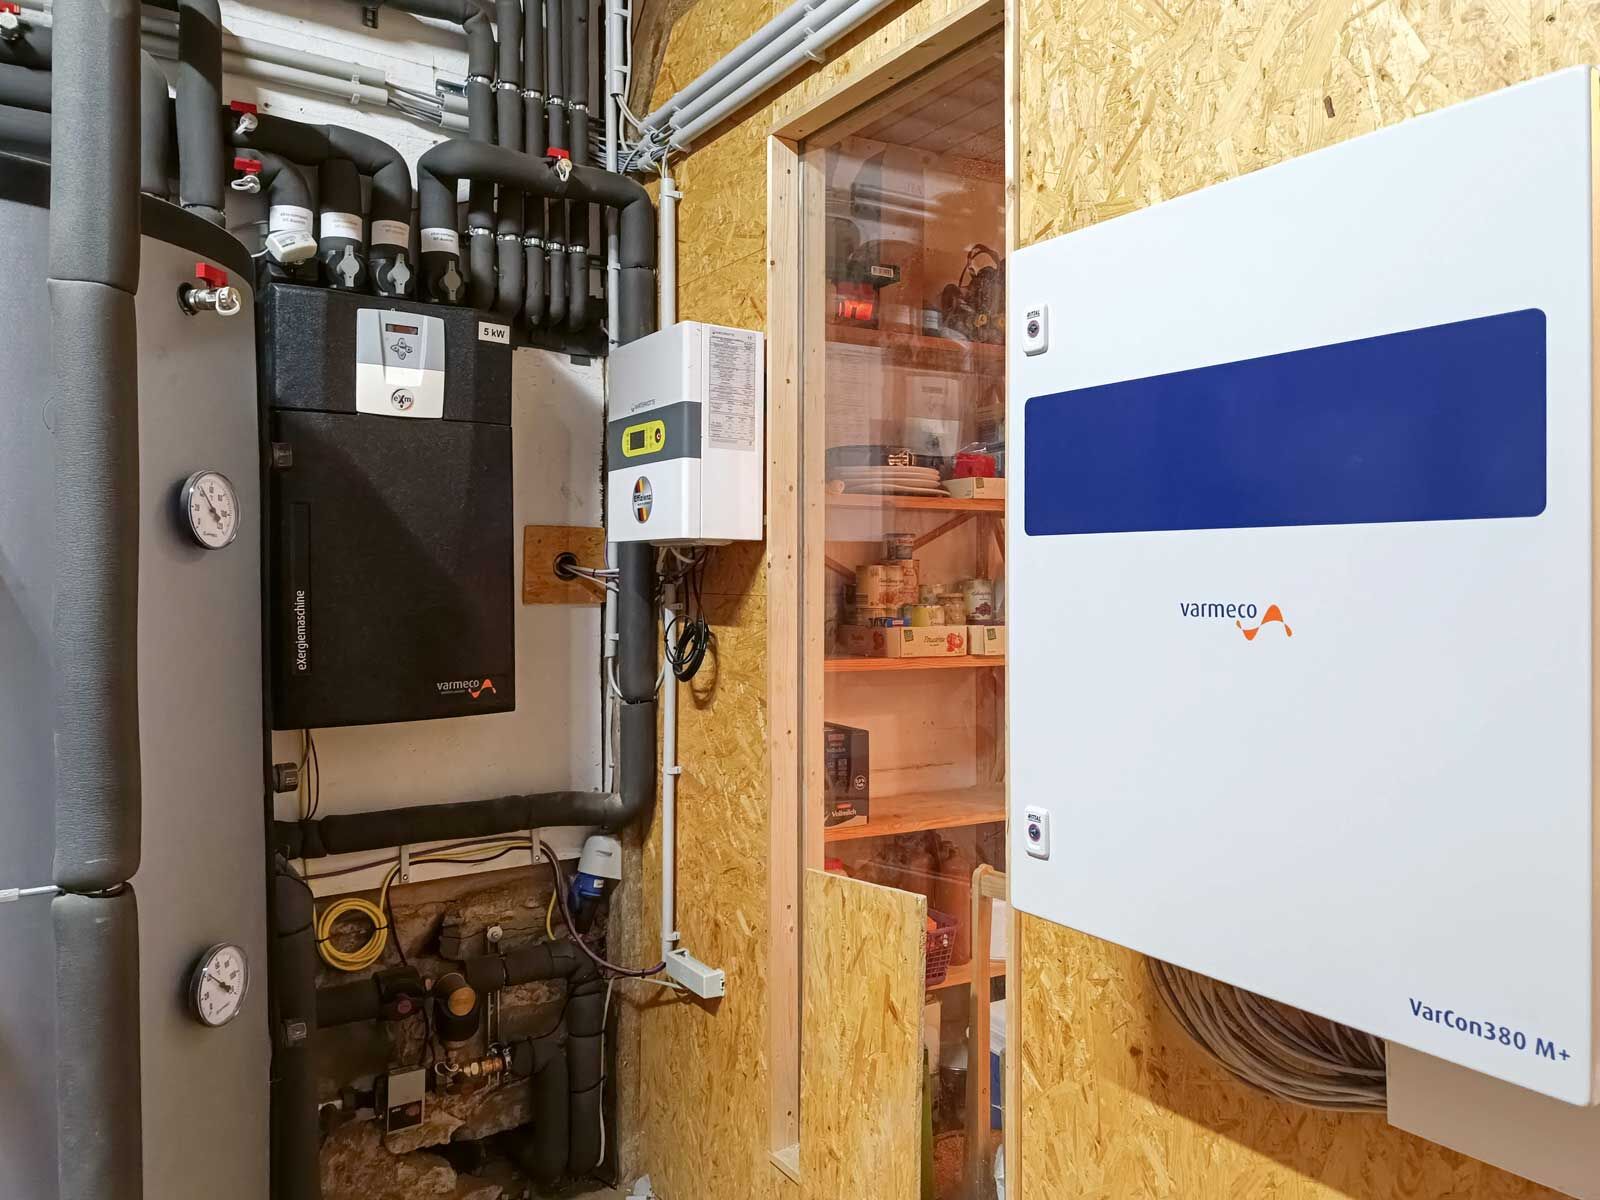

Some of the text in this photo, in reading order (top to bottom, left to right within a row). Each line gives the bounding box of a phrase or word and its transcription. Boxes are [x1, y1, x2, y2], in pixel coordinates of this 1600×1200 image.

[483, 327, 506, 339] 5 kW
[1180, 602, 1258, 619] varmeco
[436, 679, 480, 691] varmeco
[1409, 997, 1571, 1061] VarCon380 M+
